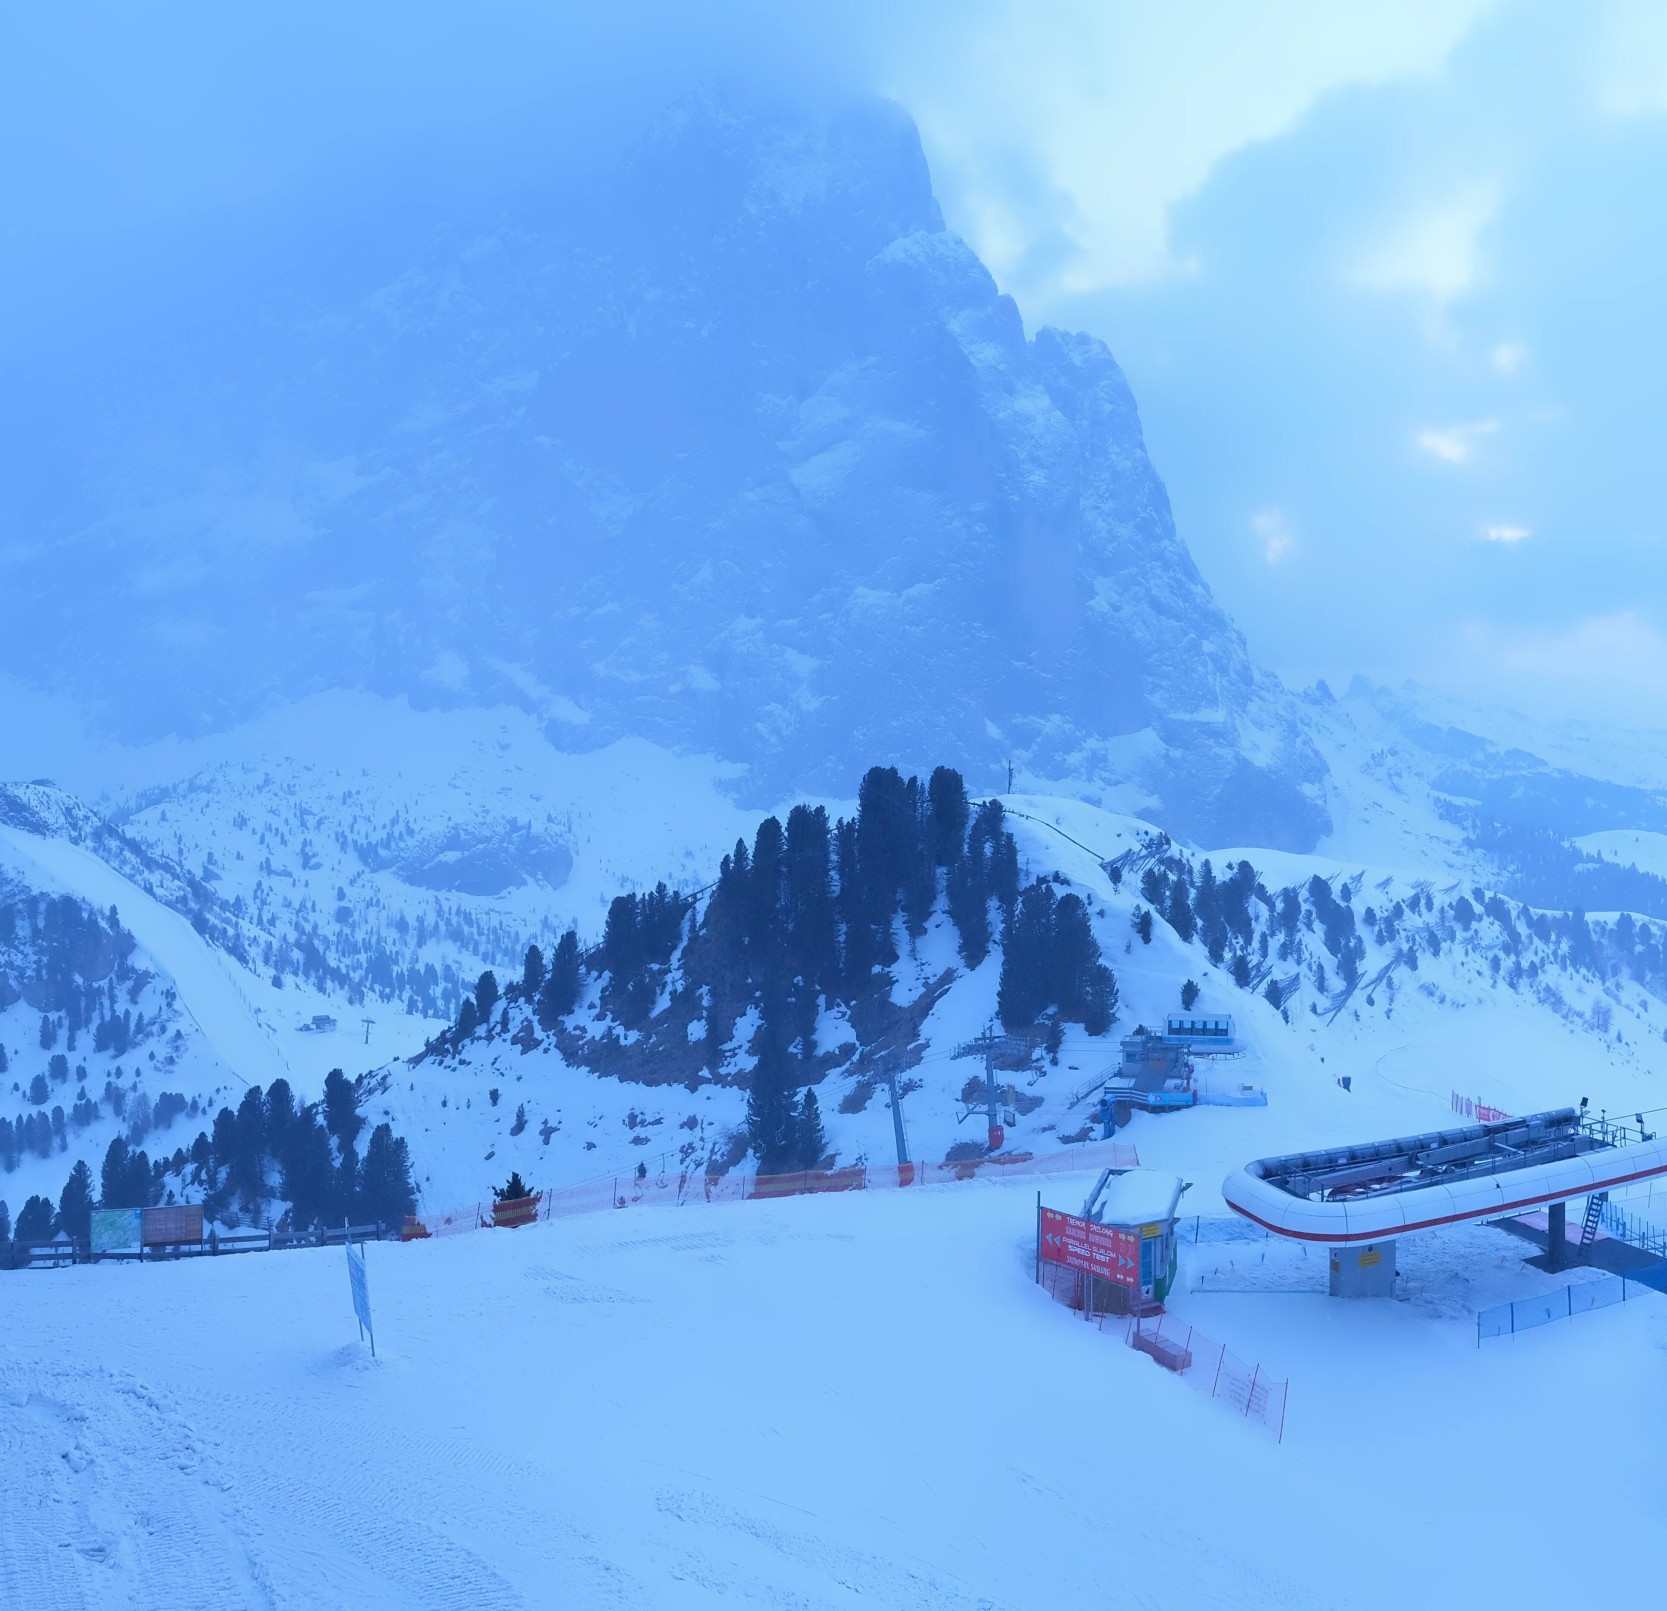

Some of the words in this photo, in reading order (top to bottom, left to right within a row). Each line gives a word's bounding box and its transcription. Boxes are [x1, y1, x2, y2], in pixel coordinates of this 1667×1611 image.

[1062, 1237, 1092, 1251] PARALLEL
[1092, 1246, 1116, 1258] SLALOM
[1068, 1245, 1090, 1257] SPEED
[1092, 1252, 1110, 1263] TEST
